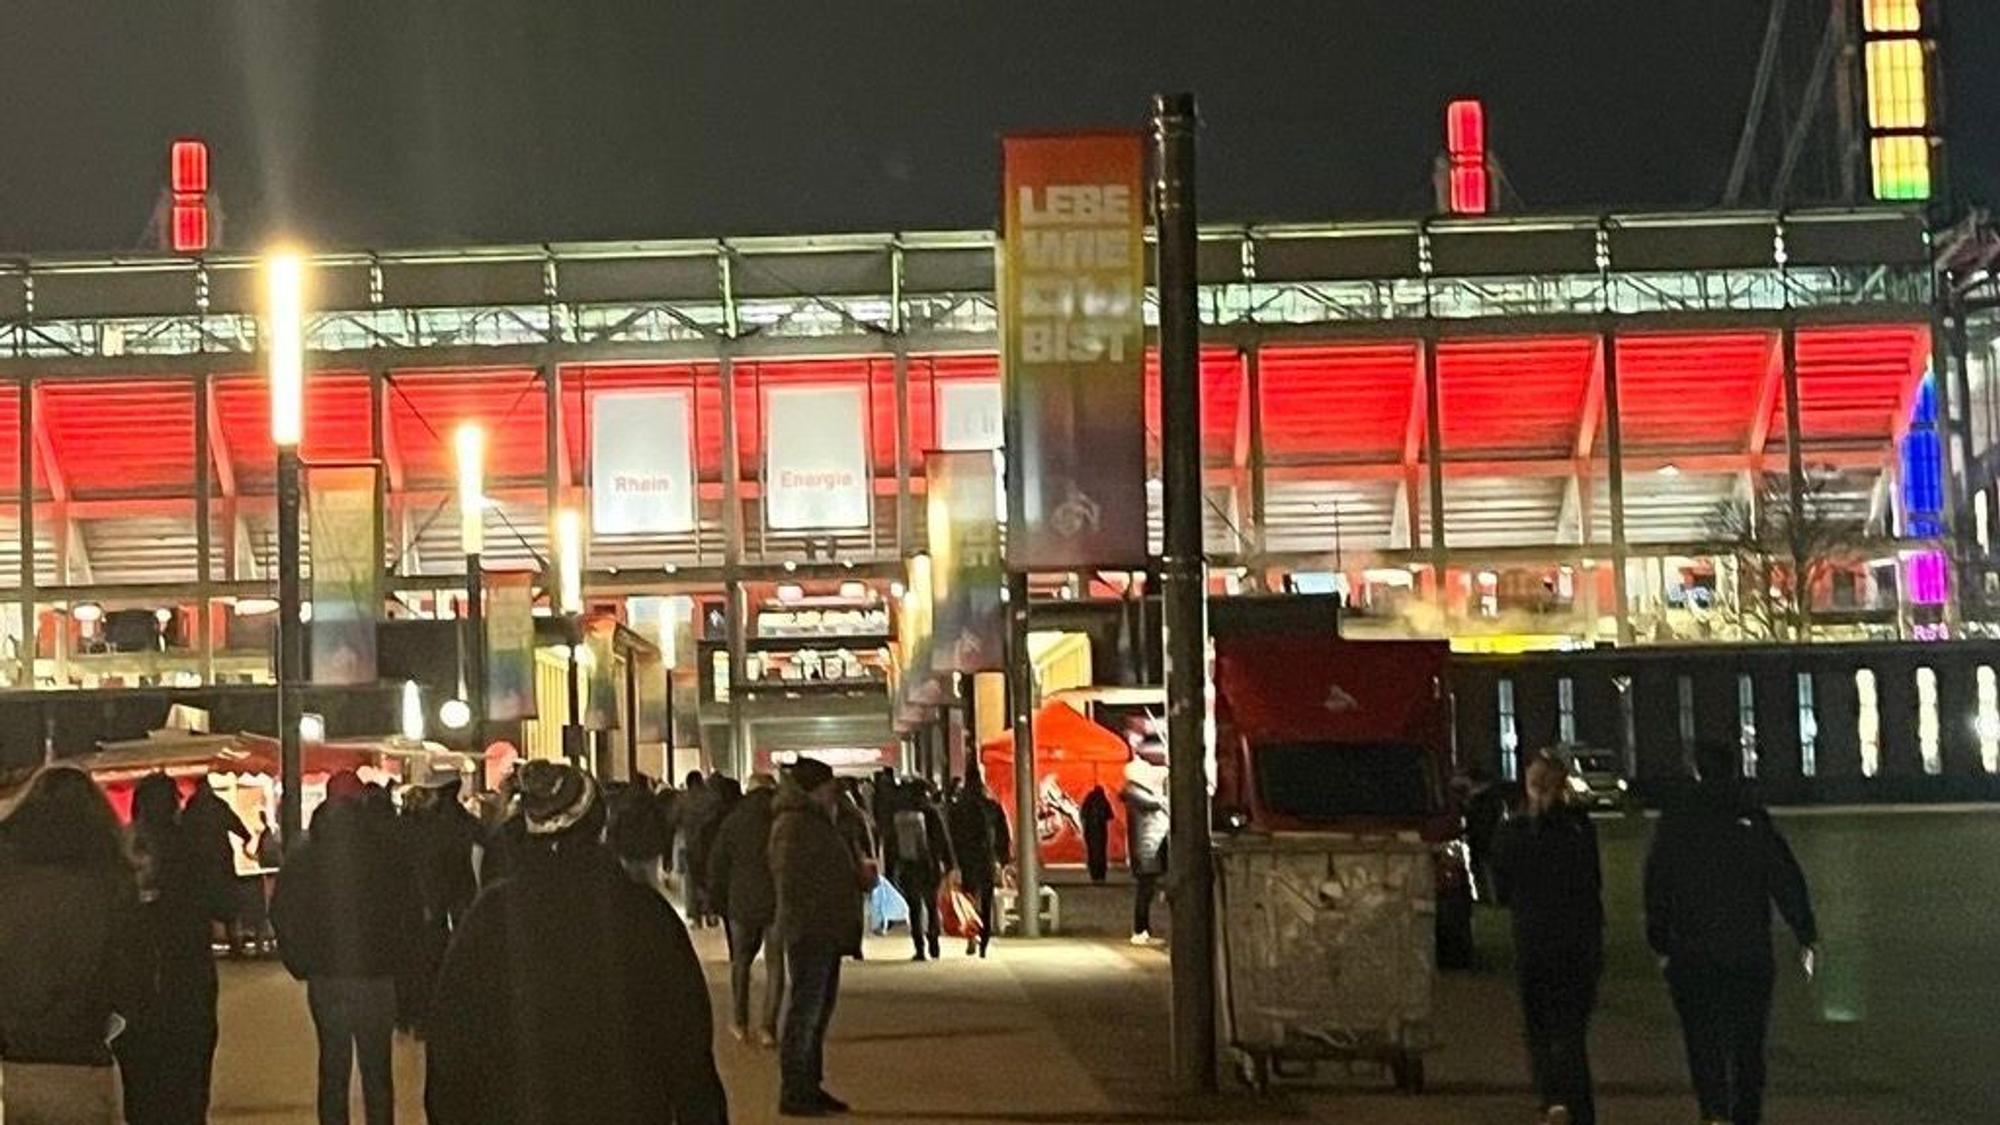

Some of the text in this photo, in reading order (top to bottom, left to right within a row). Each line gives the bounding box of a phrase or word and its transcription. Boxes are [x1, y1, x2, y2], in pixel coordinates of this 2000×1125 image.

[1019, 185, 1129, 224] LEBE
[1022, 230, 1128, 268] WIE
[1022, 321, 1131, 362] BIST
[614, 476, 669, 492] Rhein
[781, 471, 852, 489] Energie
